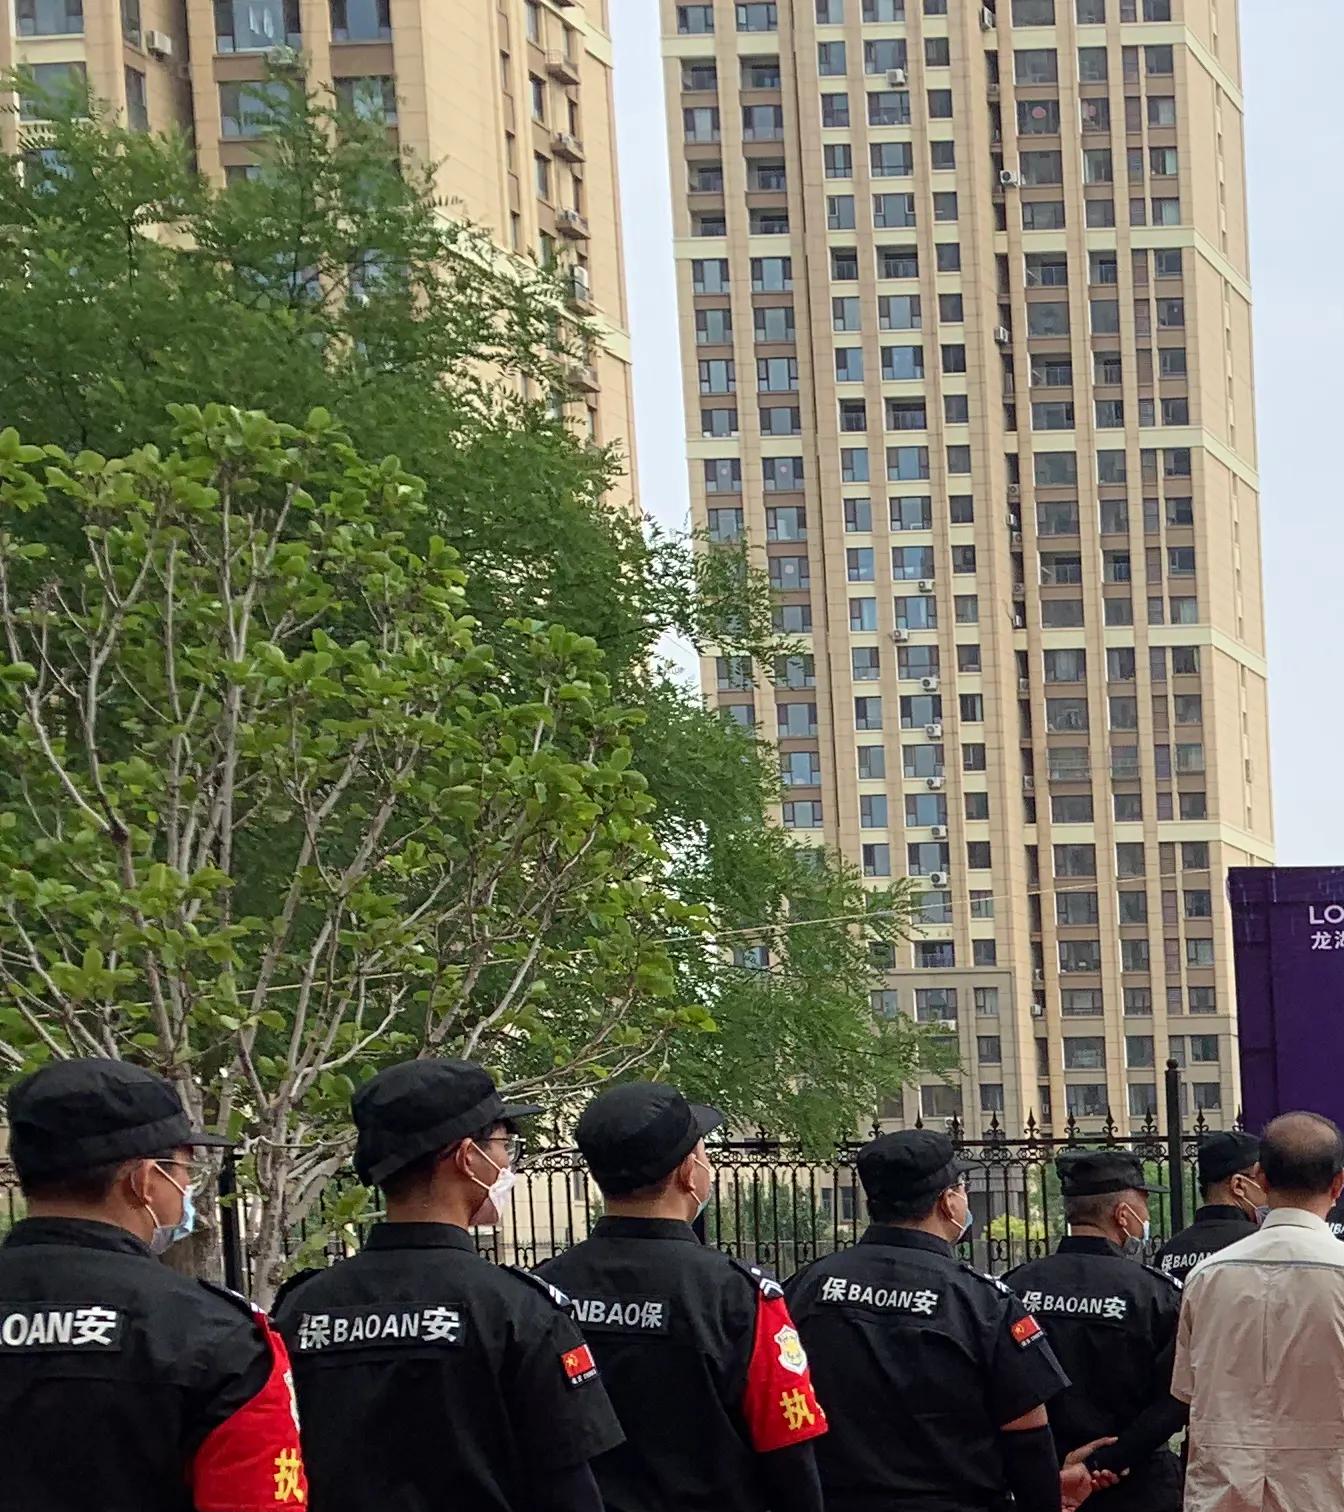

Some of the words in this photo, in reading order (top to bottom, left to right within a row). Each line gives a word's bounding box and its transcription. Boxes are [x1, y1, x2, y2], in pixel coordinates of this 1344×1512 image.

[822, 1276, 939, 1315] 保BAOAN安
[1022, 1290, 1127, 1320] 保BAOAN安
[0, 1305, 117, 1346] OAN安
[298, 1306, 460, 1350] 保BAOAN安
[780, 1383, 827, 1430] 执
